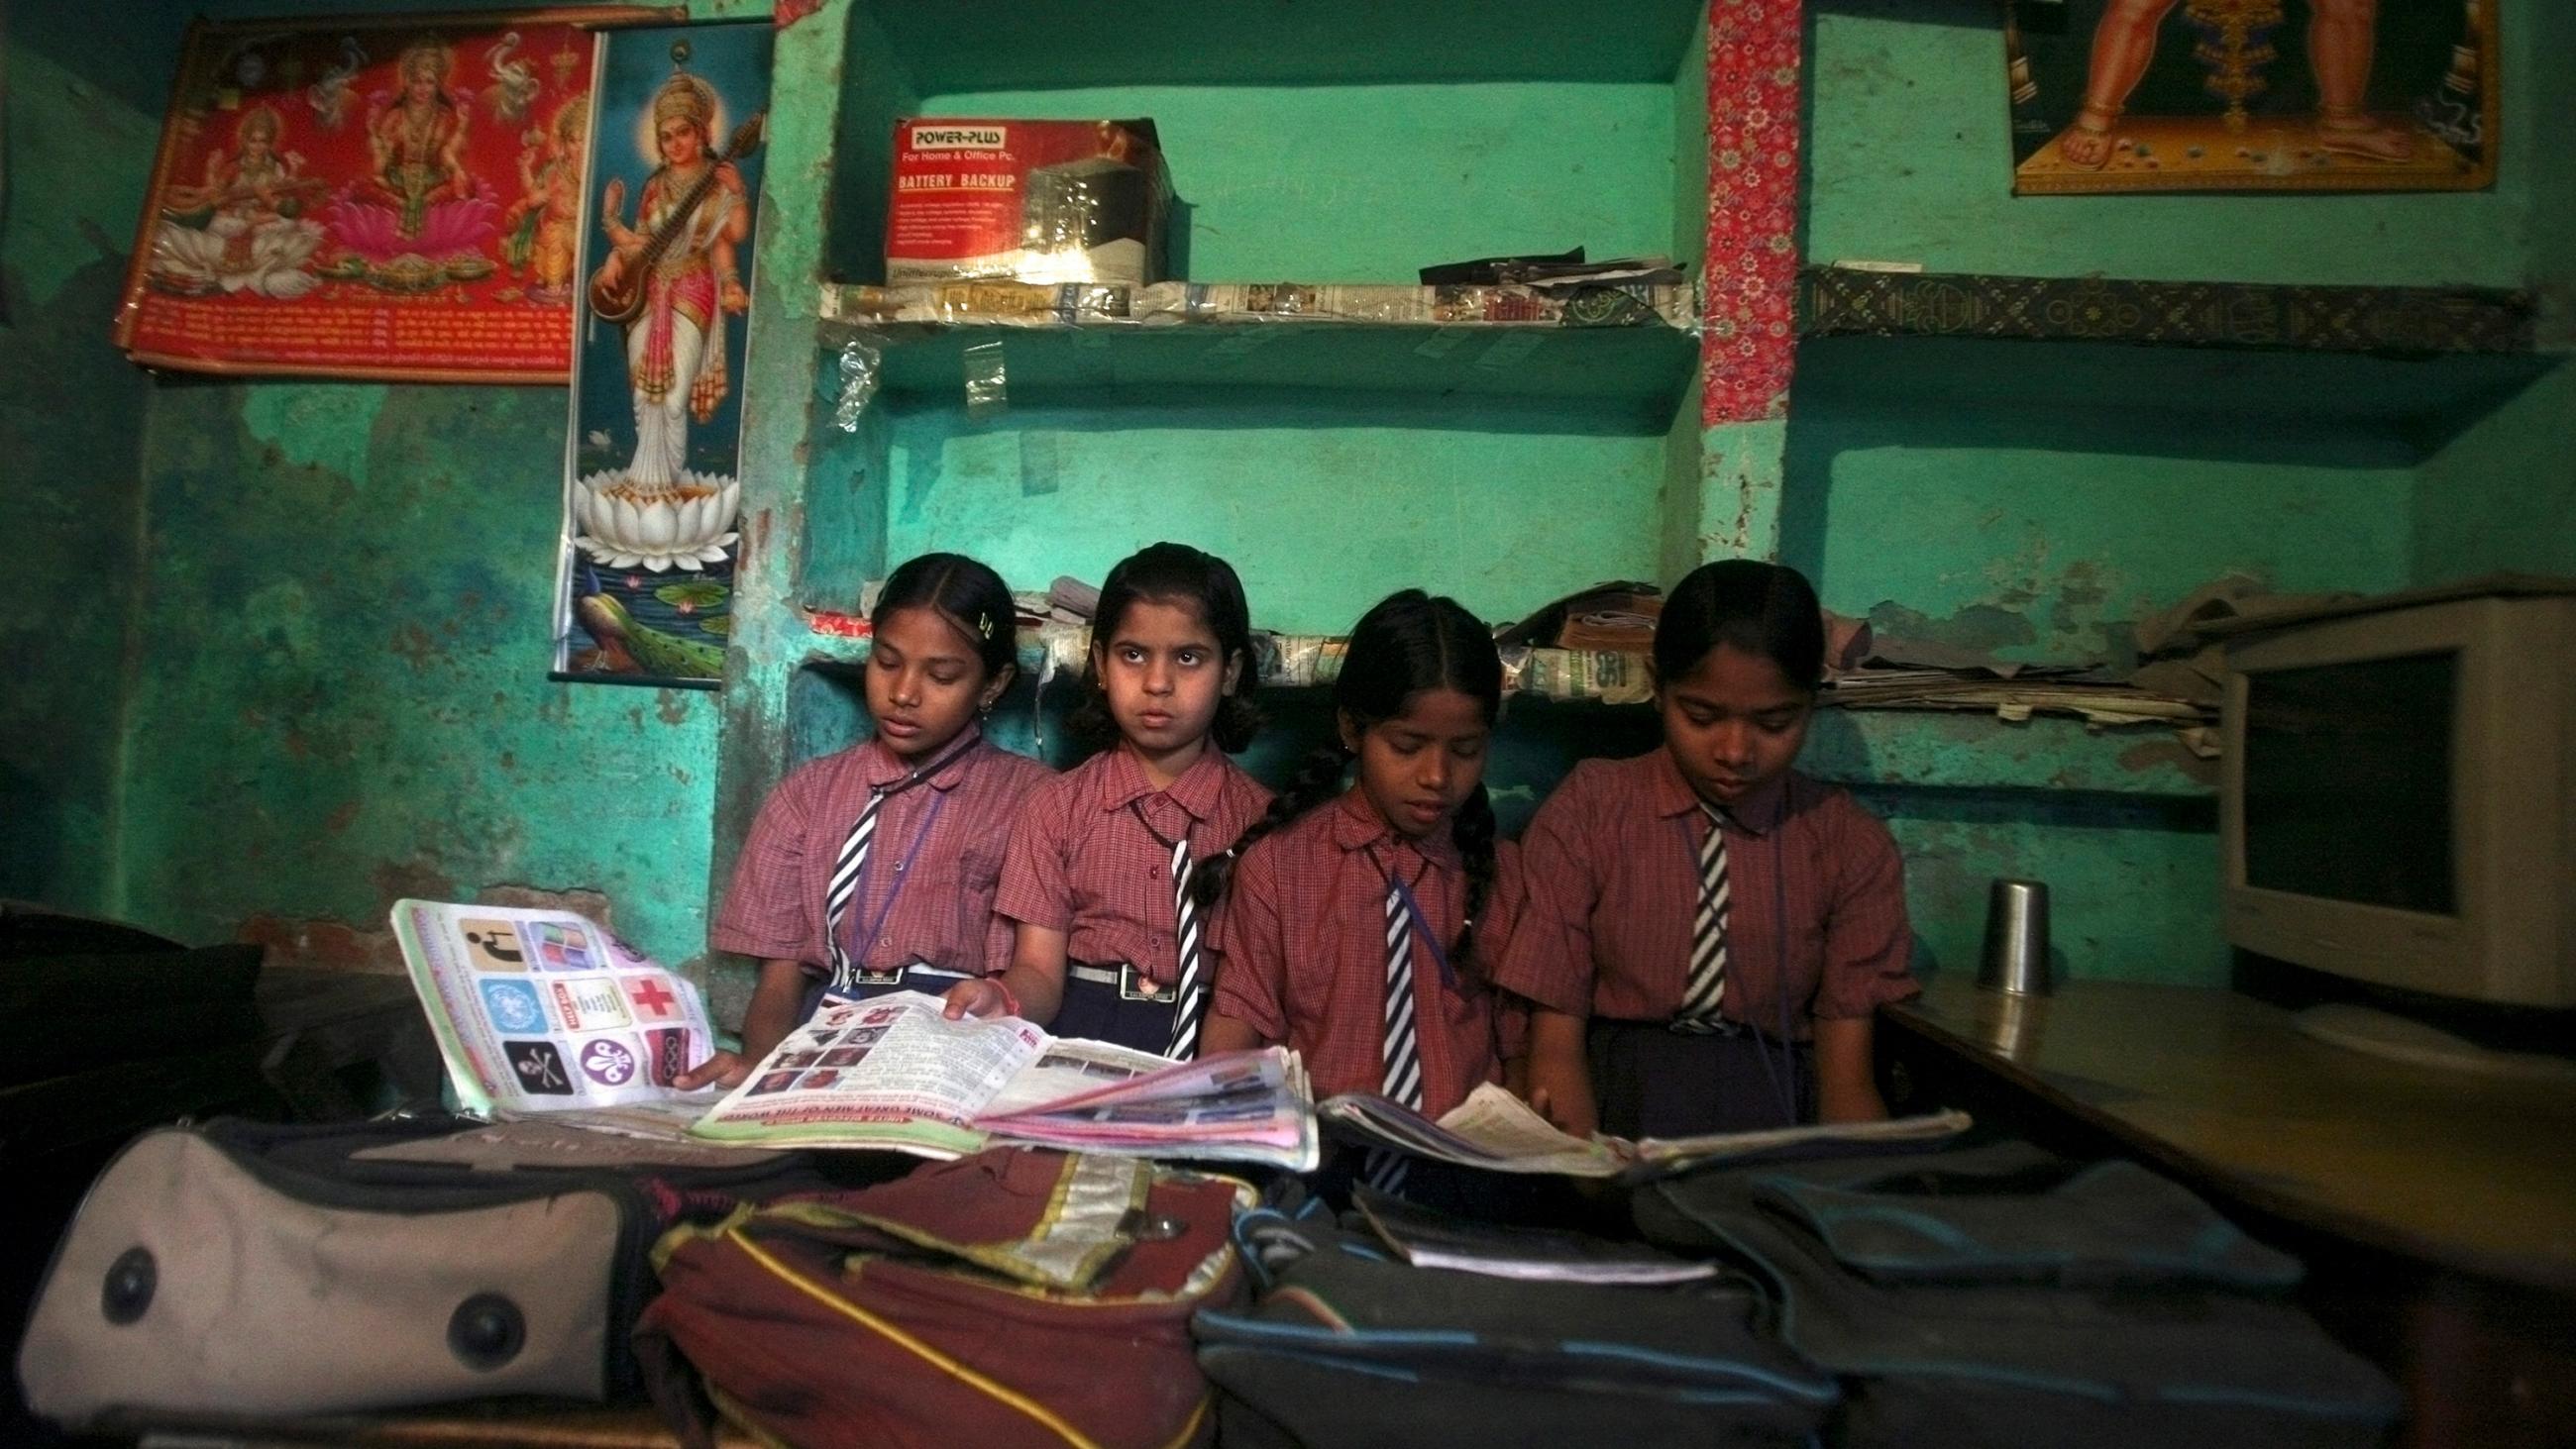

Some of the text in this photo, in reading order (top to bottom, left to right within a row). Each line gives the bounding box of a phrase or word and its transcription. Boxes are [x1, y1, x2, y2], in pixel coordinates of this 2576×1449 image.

[916, 131, 1001, 144] POWER-PLUS
[902, 152, 919, 161] For
[921, 151, 951, 160] Home
[953, 151, 961, 160] &
[964, 150, 996, 160] Office
[899, 173, 1015, 189] BATTERY BACKUP
[776, 1107, 798, 1116] THE
[823, 1104, 855, 1113] MEN
[859, 1104, 901, 1113] GREAT
[906, 1106, 943, 1120] SOME
